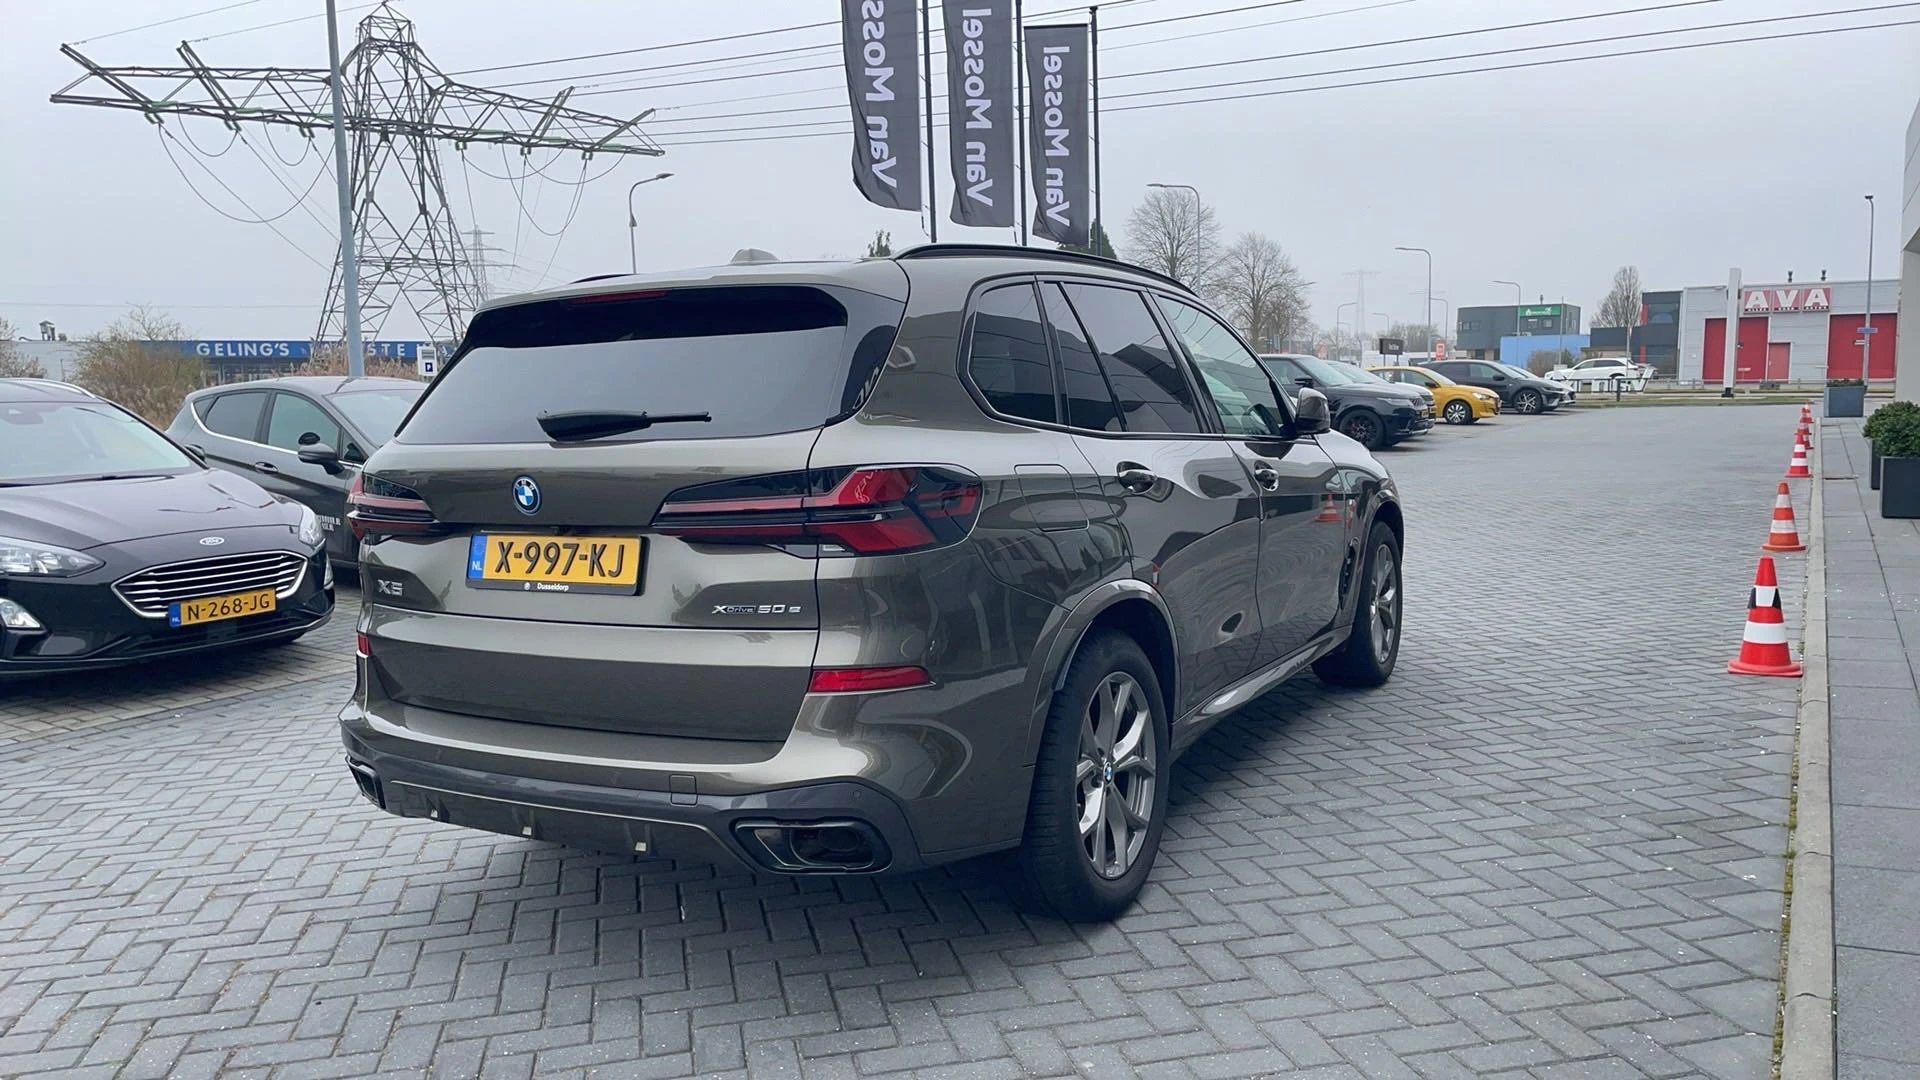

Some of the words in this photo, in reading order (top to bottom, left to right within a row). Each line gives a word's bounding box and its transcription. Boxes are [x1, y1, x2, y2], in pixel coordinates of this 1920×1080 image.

[1745, 288, 1828, 308] AVA
[196, 342, 290, 357] GELING'S
[472, 560, 482, 571] NL
[495, 541, 625, 578] X-997-KJ
[537, 582, 569, 592] Dusseldorp
[187, 593, 270, 620] N-268-JG
